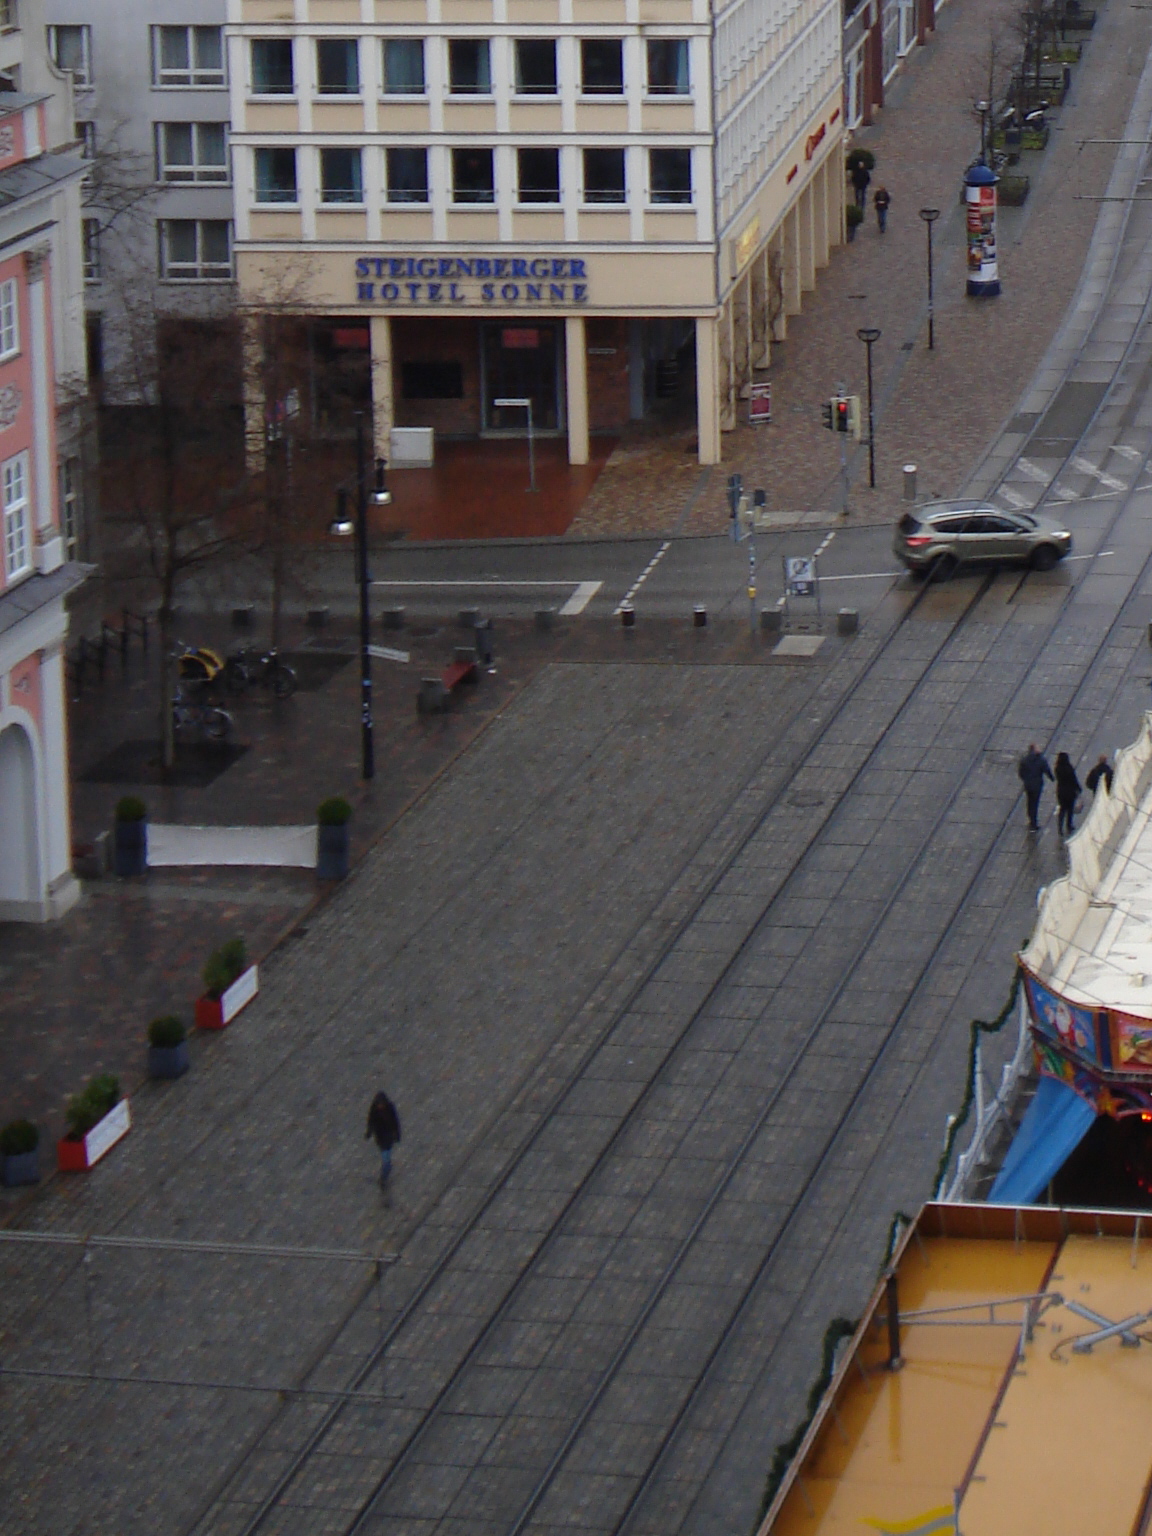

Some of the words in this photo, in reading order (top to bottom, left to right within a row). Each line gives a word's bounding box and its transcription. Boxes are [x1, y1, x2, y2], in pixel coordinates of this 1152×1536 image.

[355, 257, 588, 279] STEIGENBERGER
[356, 281, 465, 302] HOTEL
[481, 282, 589, 302] SONNE
